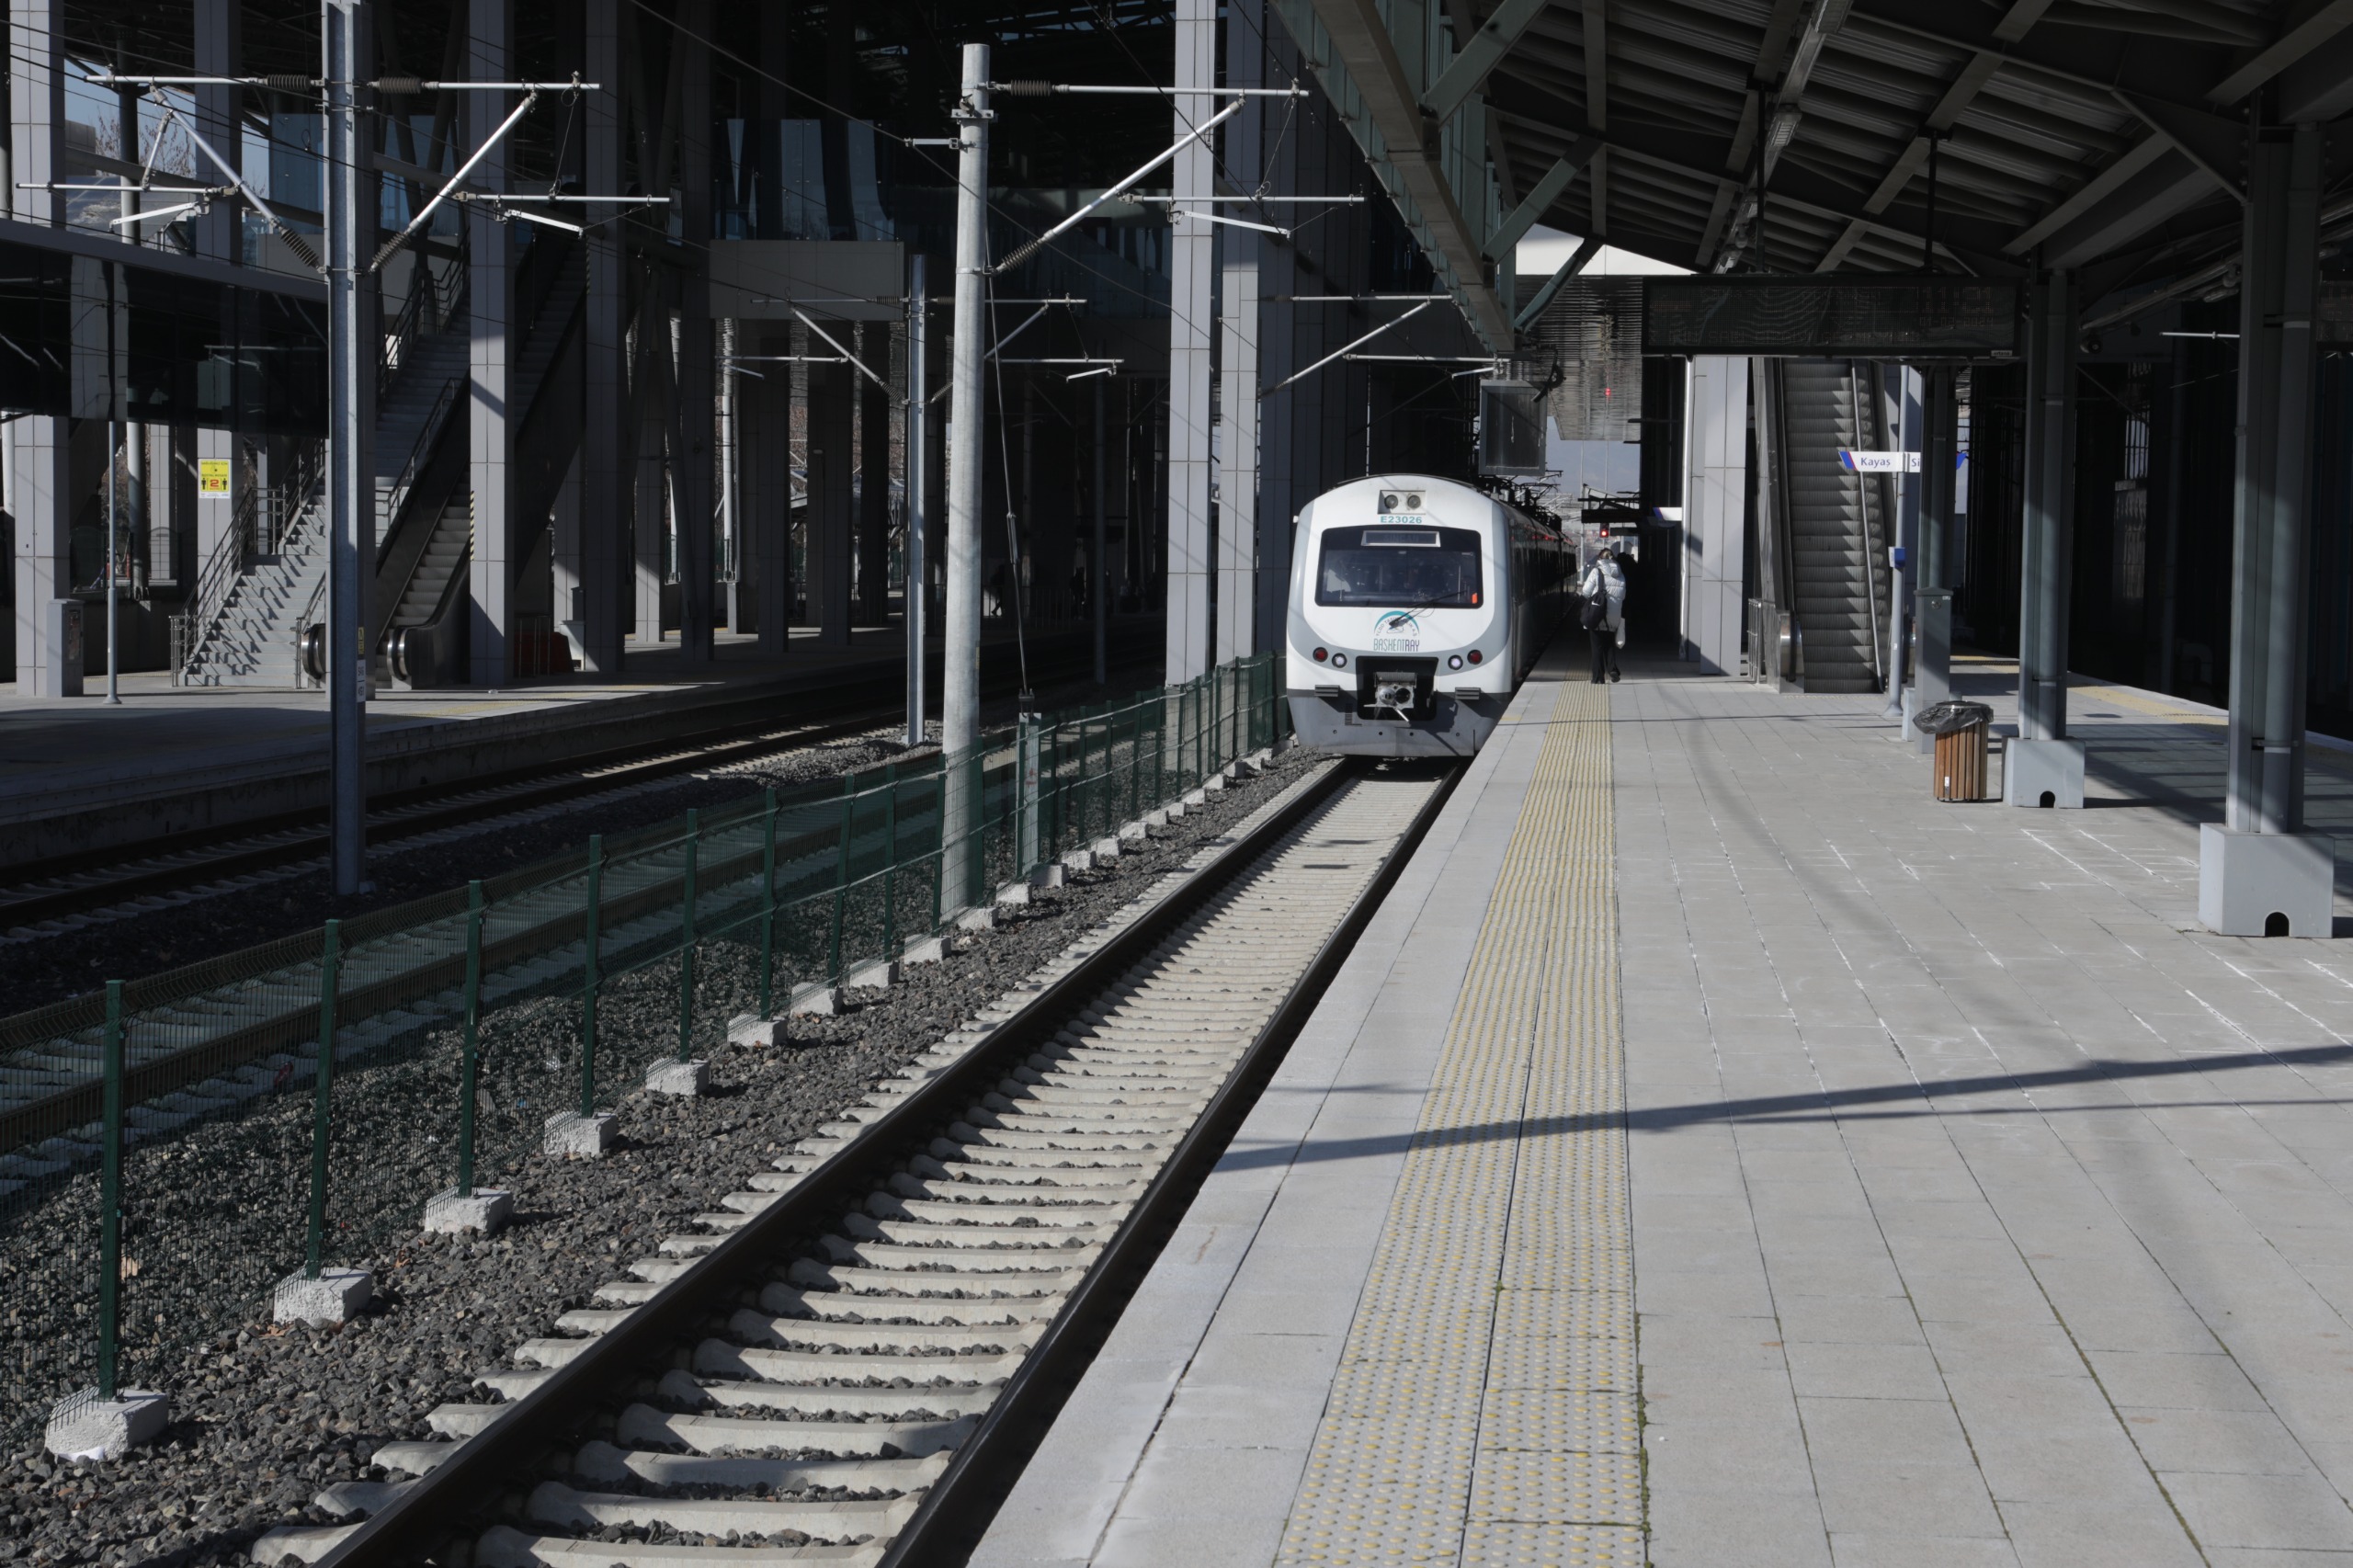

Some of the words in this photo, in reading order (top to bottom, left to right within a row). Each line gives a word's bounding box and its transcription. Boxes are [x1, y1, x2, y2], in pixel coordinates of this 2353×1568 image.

[1860, 457, 1891, 469] Kayaş
[210, 479, 220, 487] 2
[1381, 516, 1422, 524] E23026
